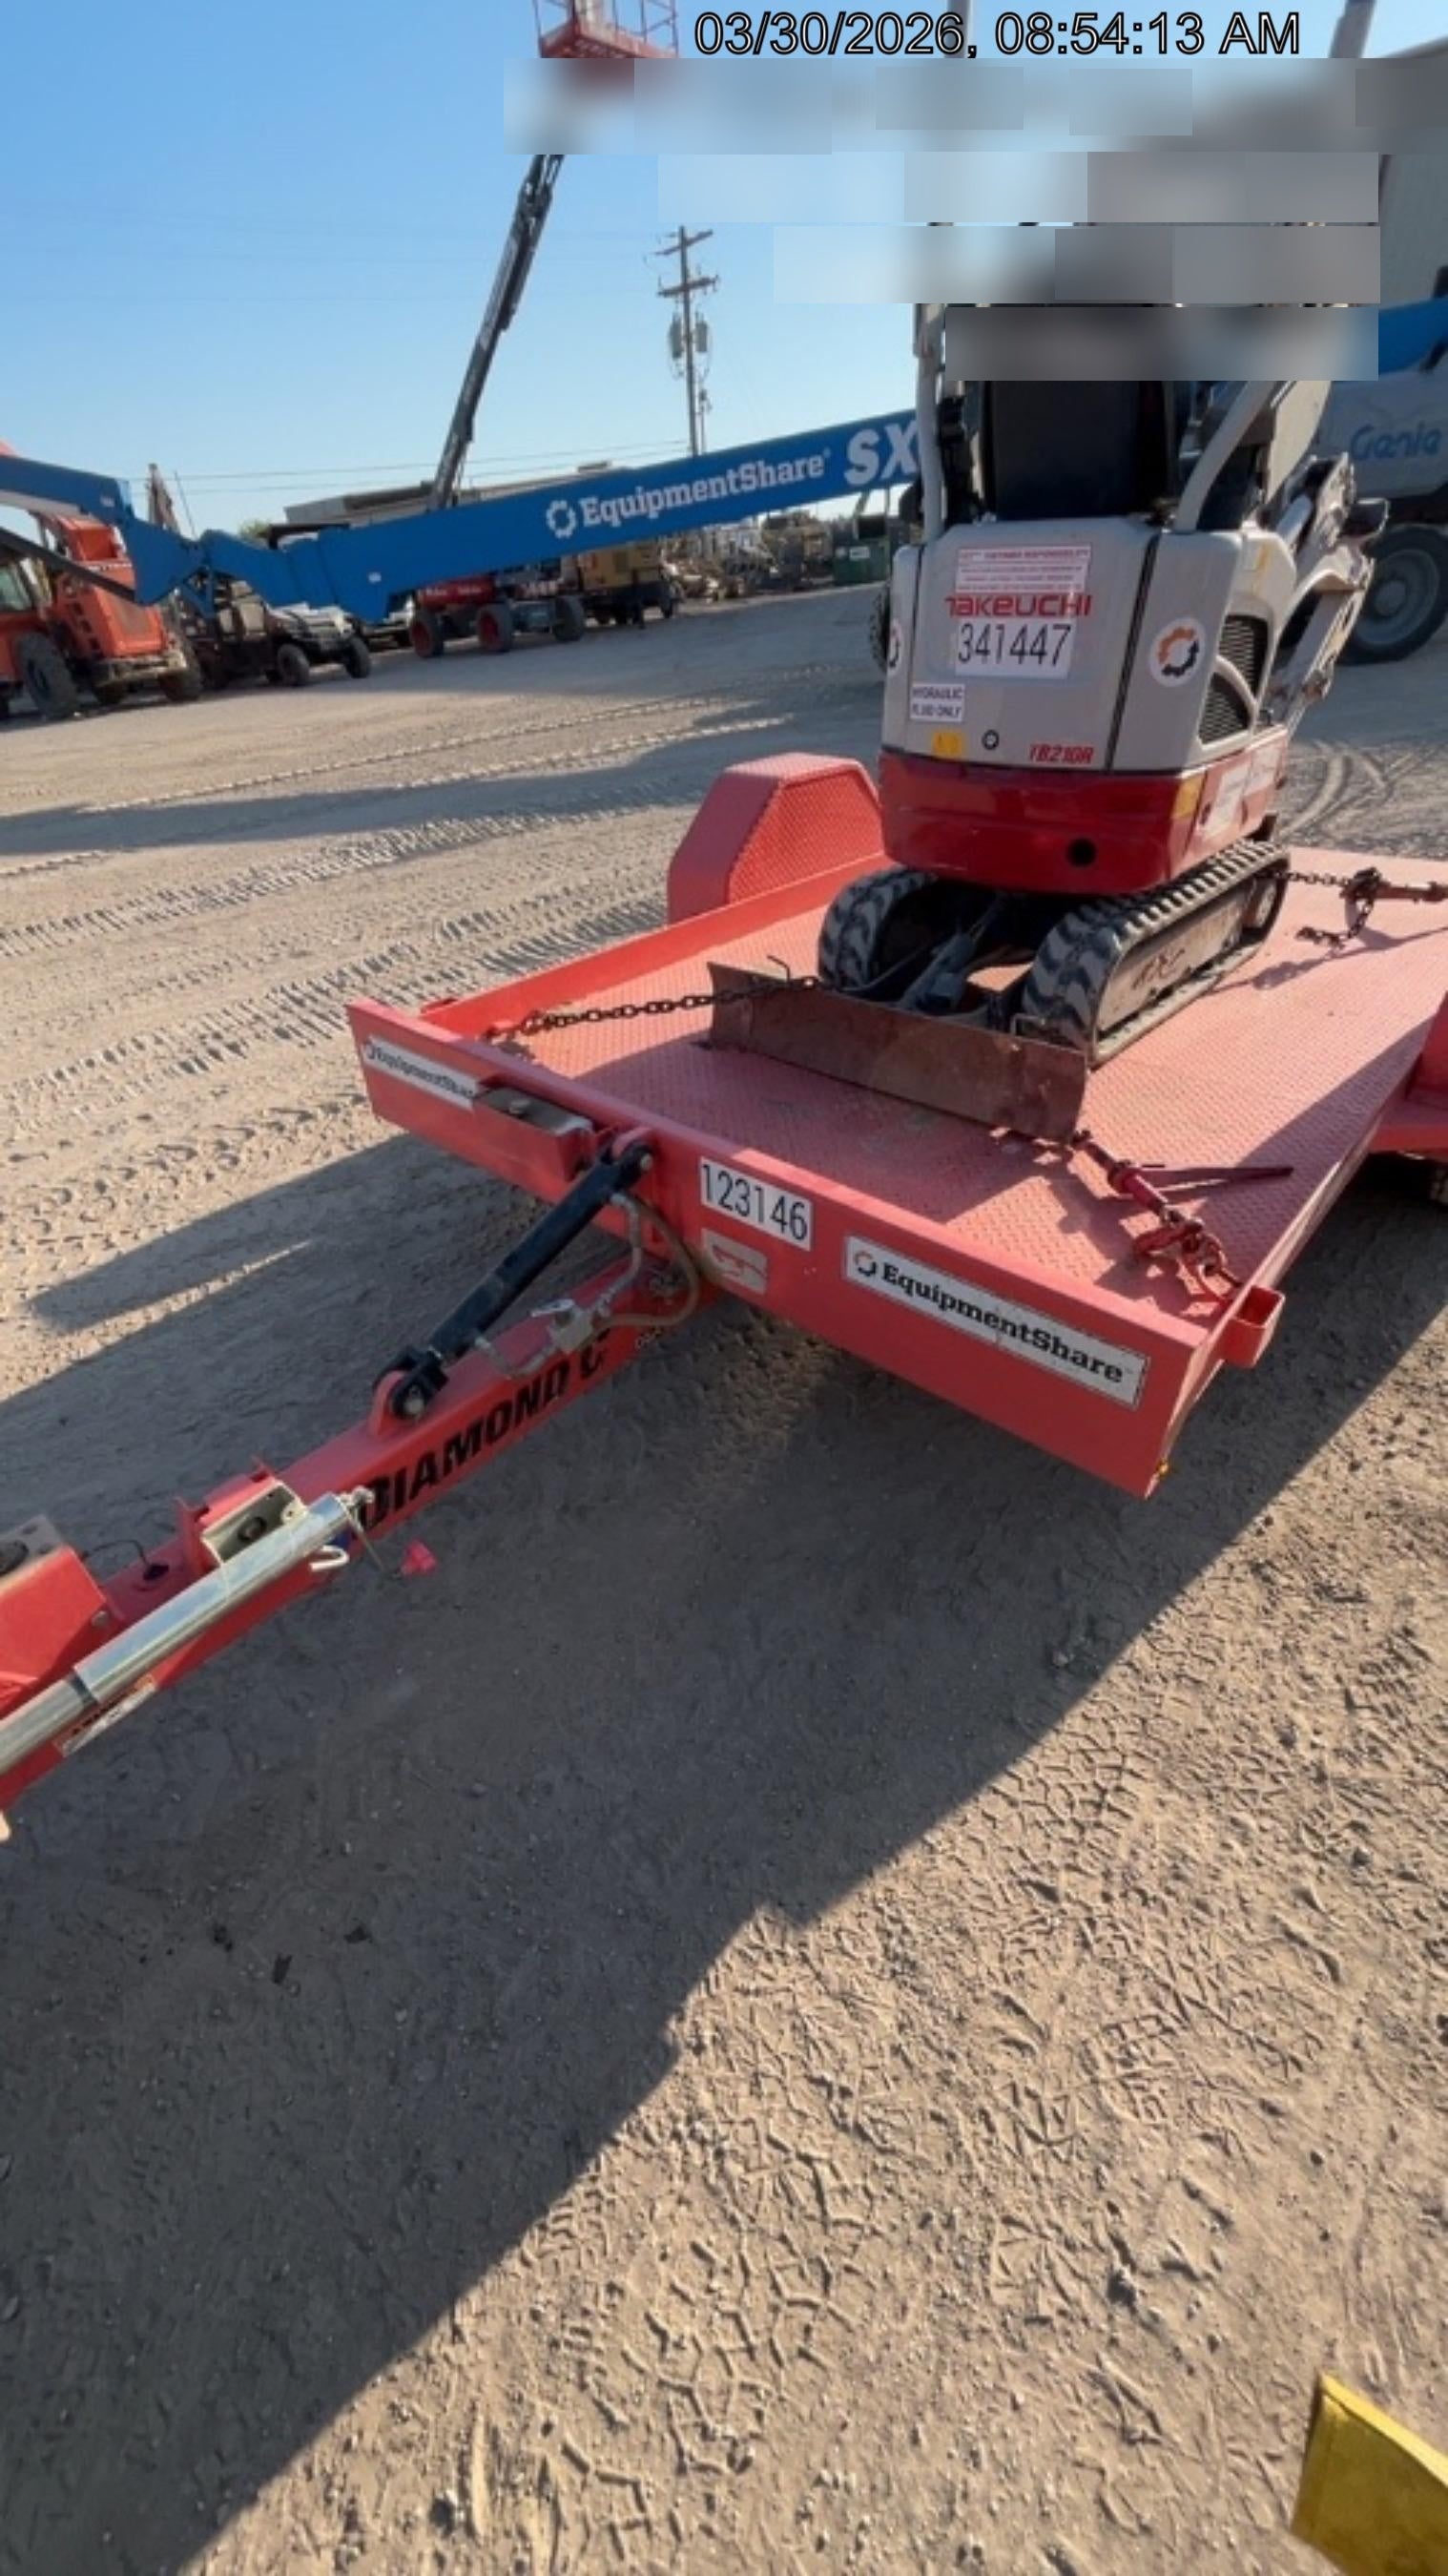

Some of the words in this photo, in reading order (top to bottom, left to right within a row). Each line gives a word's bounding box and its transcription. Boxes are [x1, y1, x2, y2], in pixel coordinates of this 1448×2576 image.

[579, 454, 825, 527] EquipmentShare
[958, 622, 1071, 667] 341447
[701, 1163, 808, 1241] 123146
[879, 1260, 1124, 1384] EquipmentShare
